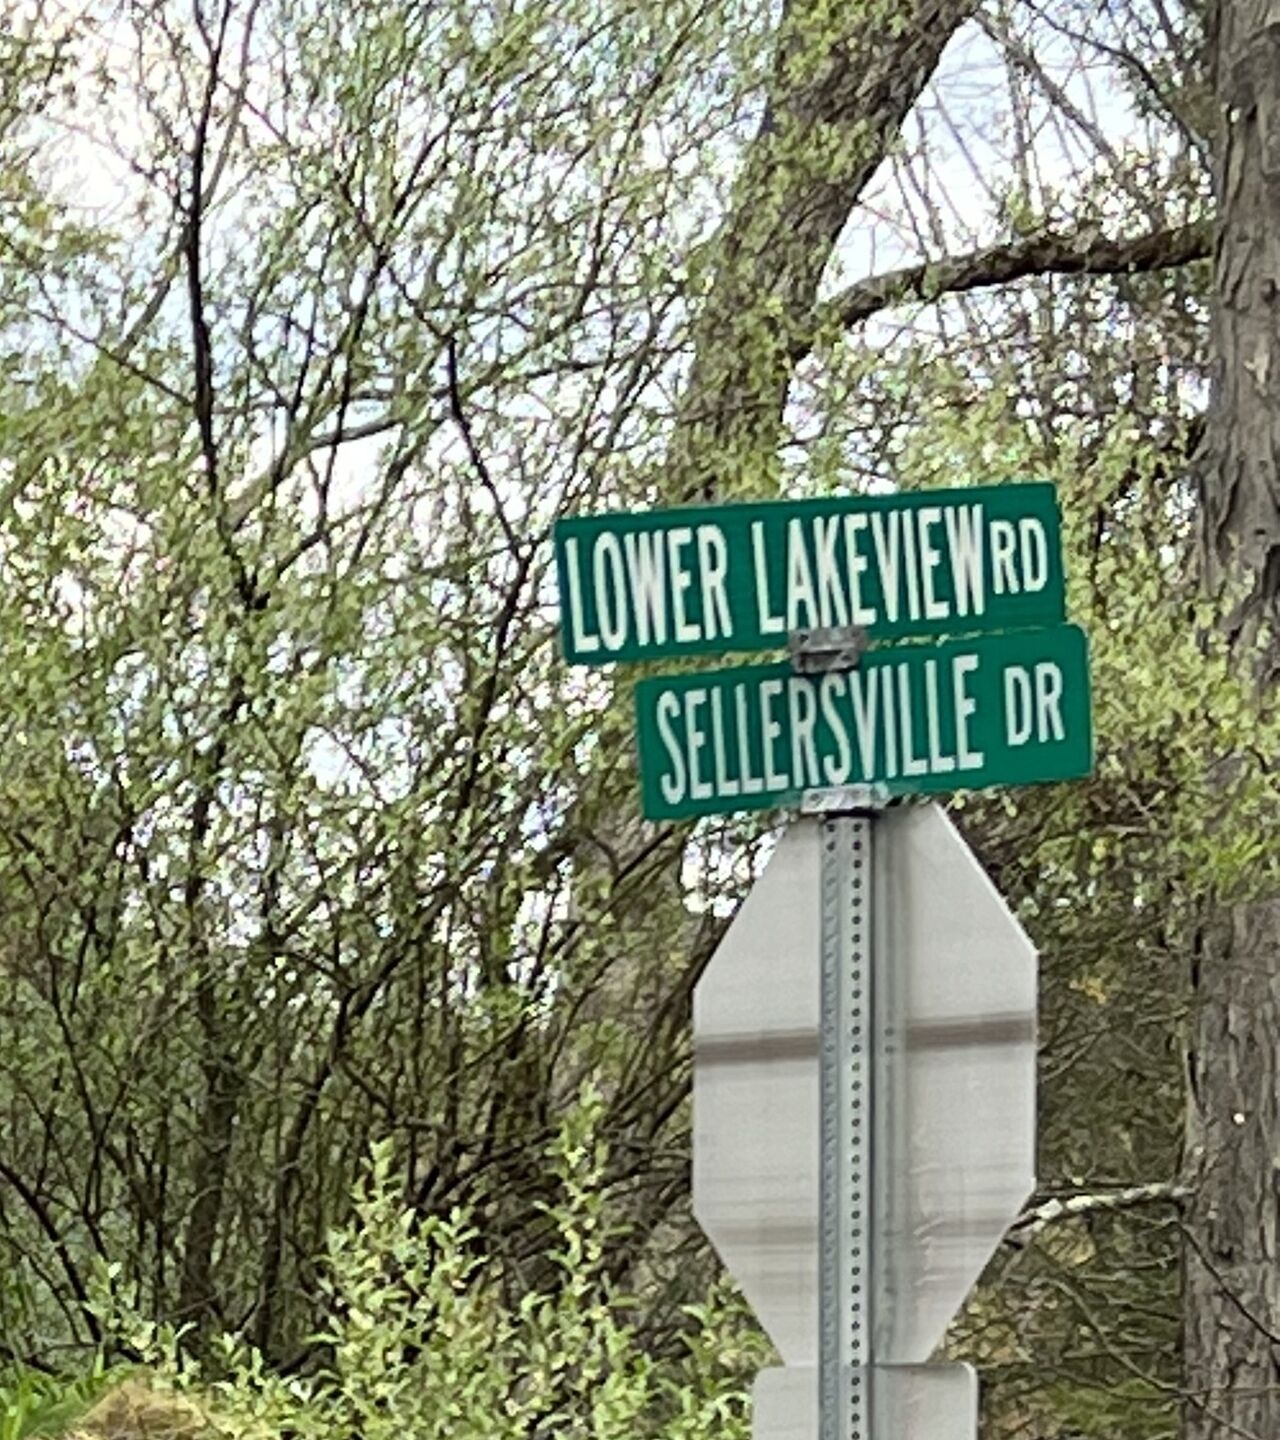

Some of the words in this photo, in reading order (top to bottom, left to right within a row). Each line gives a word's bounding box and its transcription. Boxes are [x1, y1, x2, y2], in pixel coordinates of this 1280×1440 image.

[563, 523, 733, 654] LOWER
[750, 503, 986, 635] LAKEVIEW
[989, 517, 1049, 597] RD
[654, 654, 986, 806] SELLERSVILLE
[1003, 660, 1066, 748] DR
